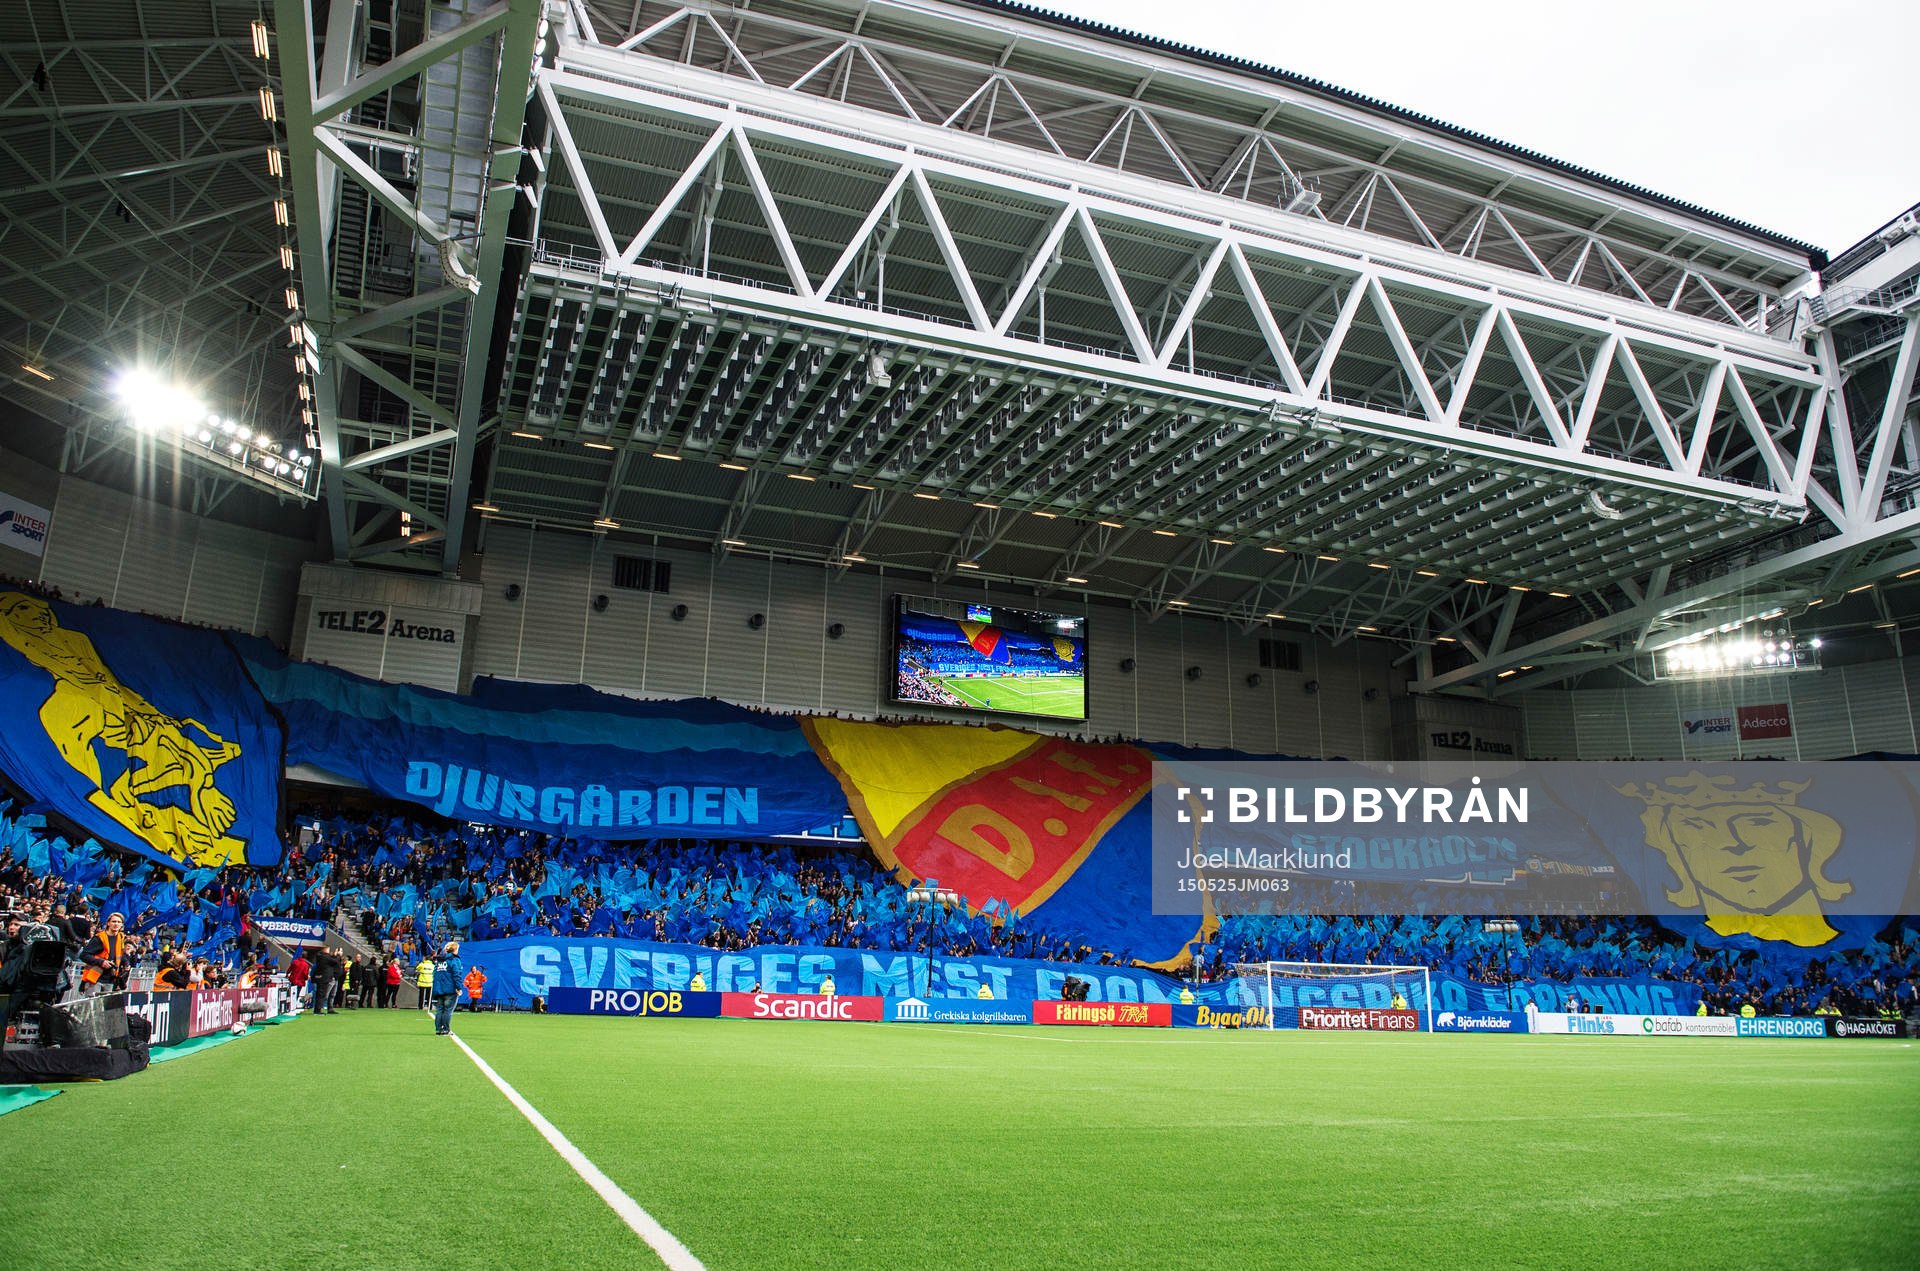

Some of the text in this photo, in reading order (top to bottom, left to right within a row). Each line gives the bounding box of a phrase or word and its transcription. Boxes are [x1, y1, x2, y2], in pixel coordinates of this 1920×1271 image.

[14, 512, 46, 532] INTER
[11, 523, 45, 542] SPORT
[318, 610, 456, 644] TELE2 Arena
[1703, 717, 1731, 726] INTER
[1703, 725, 1731, 734] SPORT
[1743, 717, 1788, 729] Adecco
[1430, 731, 1513, 755] TELE2 Arena
[405, 760, 759, 827] DJURGÅRDEN
[1291, 832, 1517, 871] STOCKHOLM
[520, 945, 836, 997] SVERIGES
[862, 953, 1013, 1000] MEST
[590, 989, 683, 1016] PROJOB
[753, 994, 853, 1019] Scandic
[934, 1010, 1027, 1023] Grekiska kolgrillsbaren
[1056, 1003, 1116, 1023] Färingsö
[1302, 1009, 1416, 1030] Prioritet Finans
[1457, 1015, 1512, 1030] Björnkläder
[1567, 1015, 1615, 1034] Flinks
[1655, 1018, 1736, 1033] bafab kontorsmöbler
[1739, 1018, 1823, 1036] EHRENBORG
[1846, 1021, 1897, 1035] HAGAKÖKET
